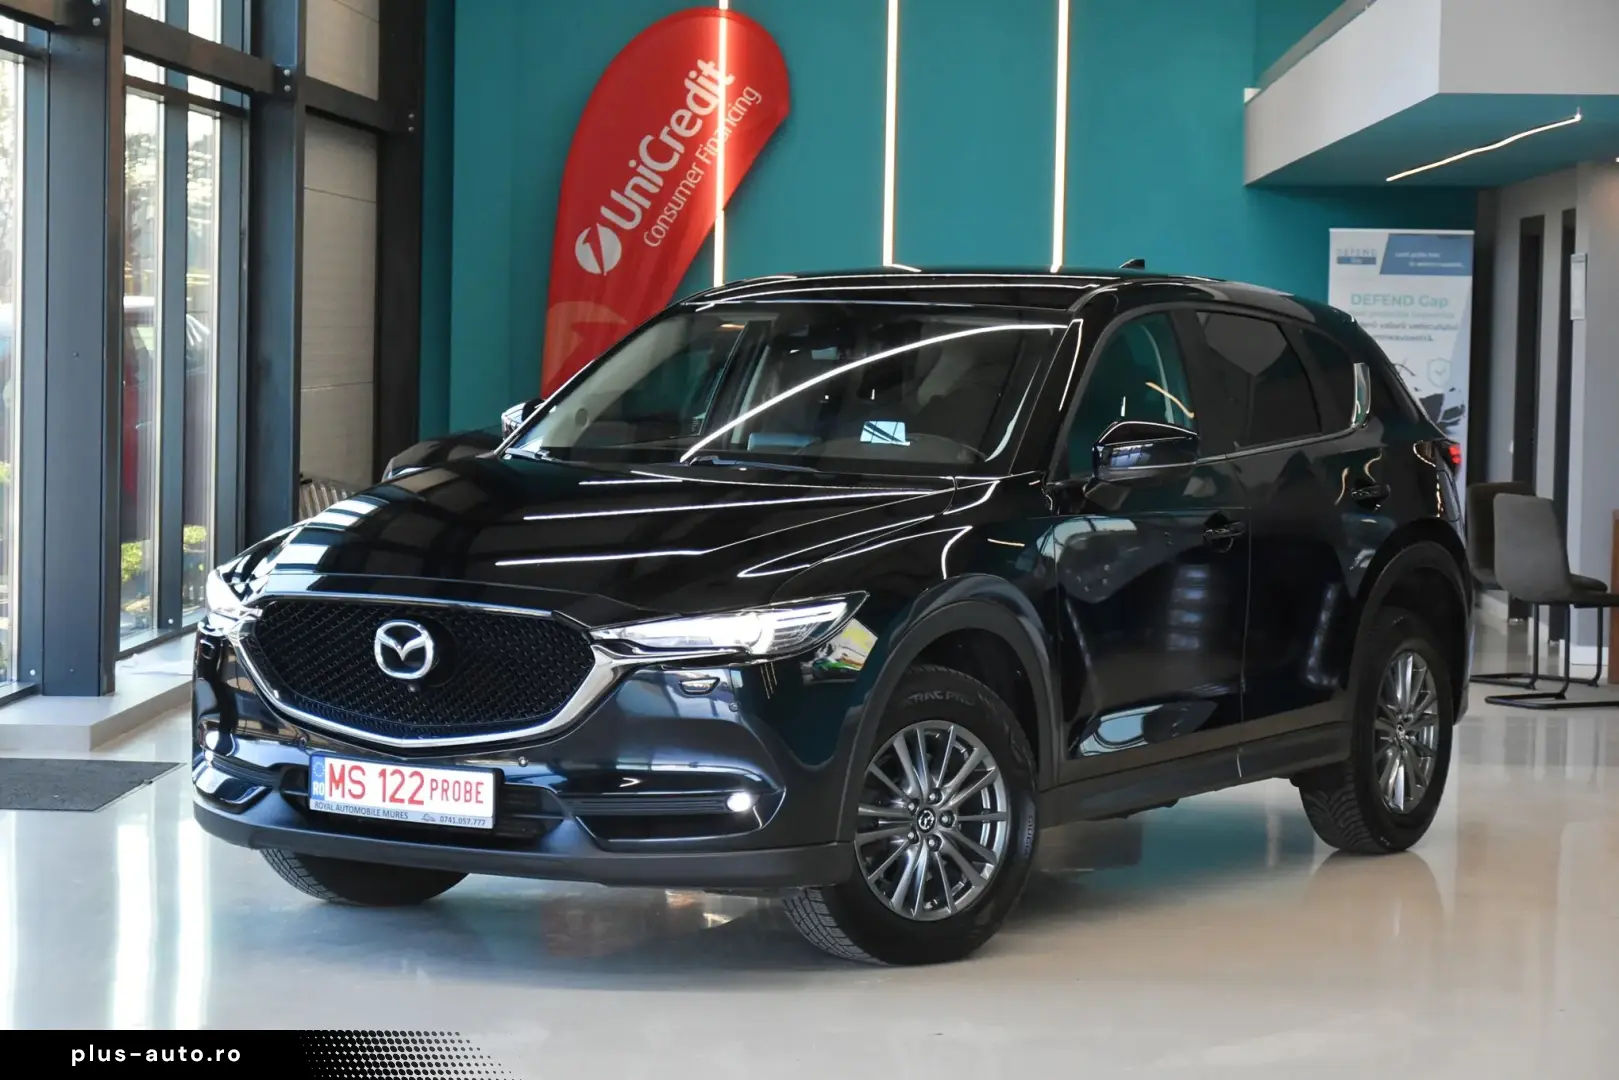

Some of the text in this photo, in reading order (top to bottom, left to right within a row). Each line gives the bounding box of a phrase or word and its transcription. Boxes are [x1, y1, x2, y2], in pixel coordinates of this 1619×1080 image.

[600, 59, 735, 230] UniCredit
[643, 86, 762, 247] Consumer Financing
[1350, 293, 1449, 309] DEFEND Gap
[312, 781, 325, 796] RO
[329, 763, 484, 805] MS 122 PROBE
[314, 801, 487, 827] ROYAL AUTOMOBILE MURES 0741.057.777
